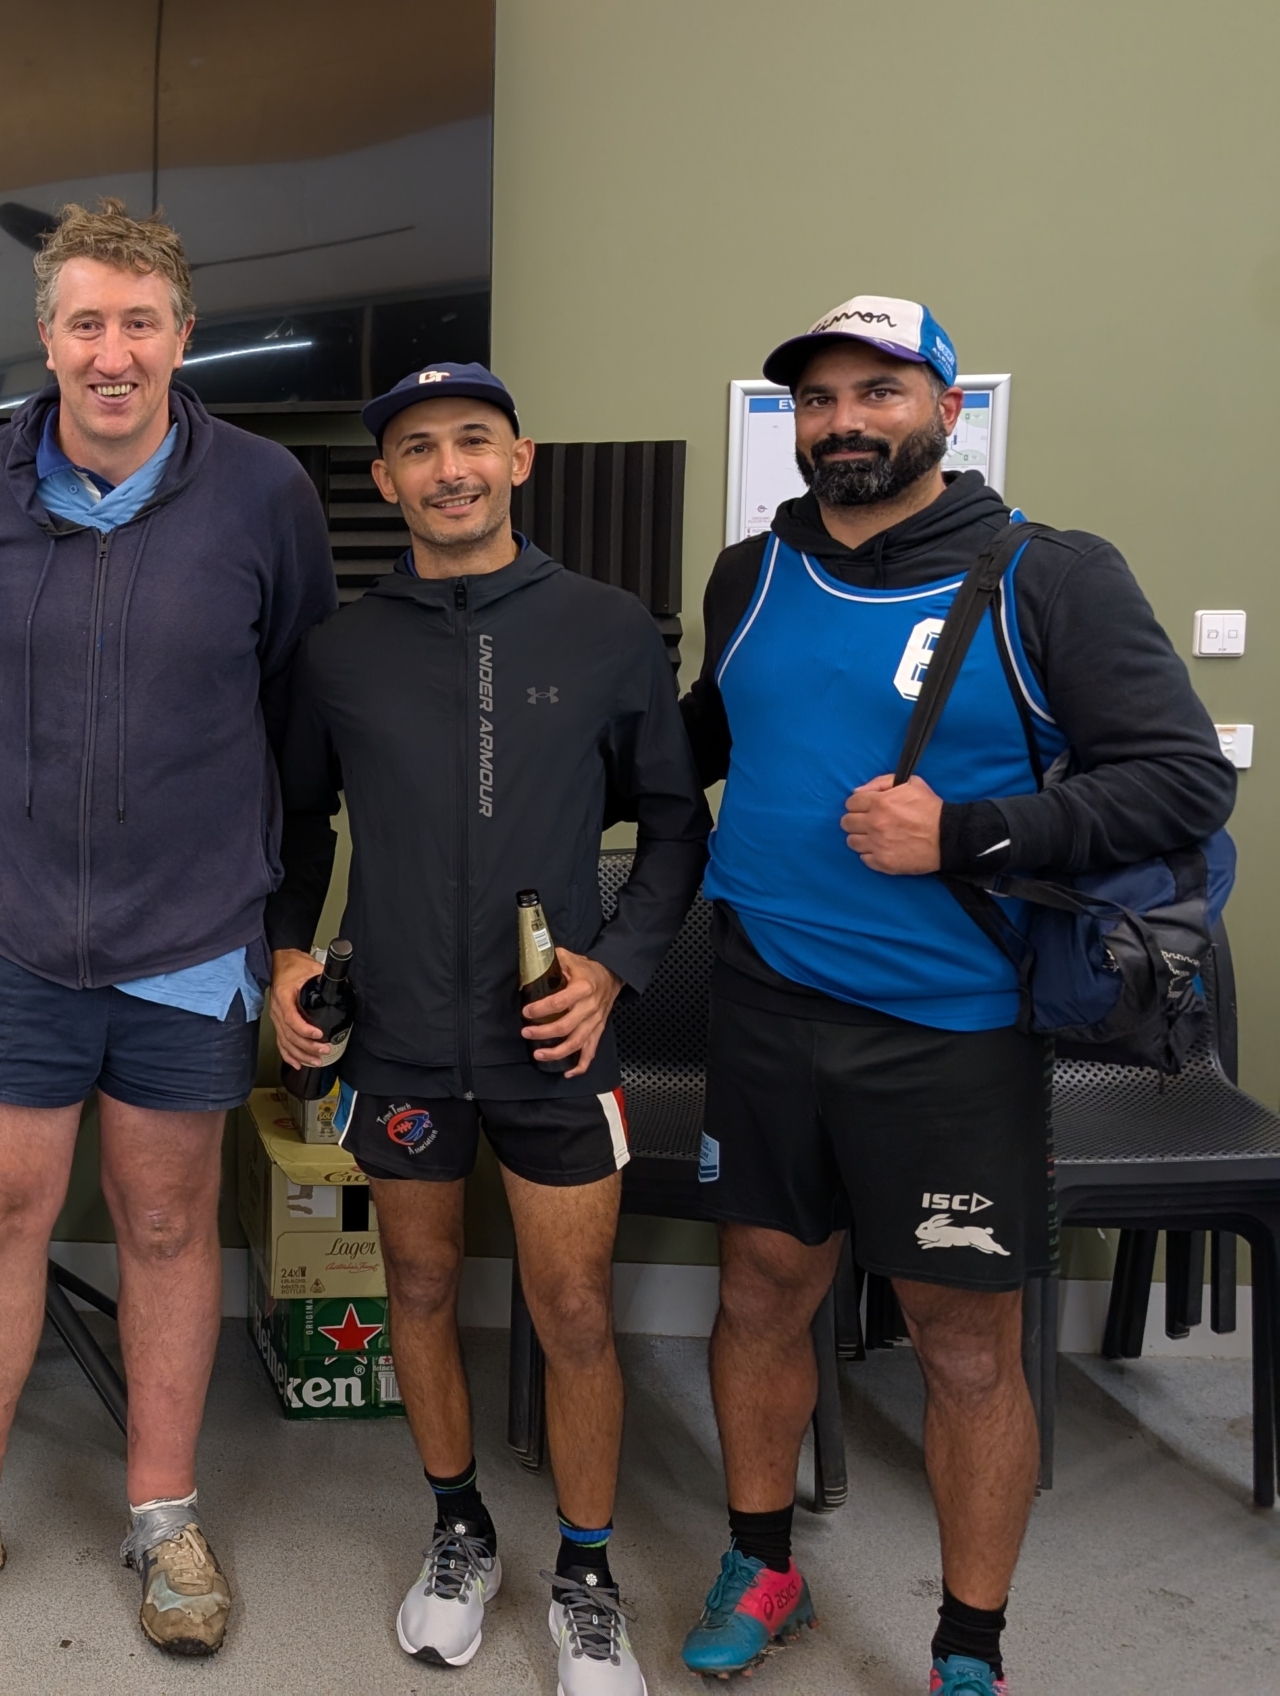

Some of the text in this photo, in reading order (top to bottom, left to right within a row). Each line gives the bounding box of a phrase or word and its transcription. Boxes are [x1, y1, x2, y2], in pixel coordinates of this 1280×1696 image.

[778, 399, 796, 410] EV
[478, 634, 494, 818] UNDER ARMOUR
[324, 1171, 368, 1183] Cro
[922, 1192, 970, 1210] ISC
[325, 1238, 377, 1260] Lager
[305, 1299, 314, 1336] ORIGINA
